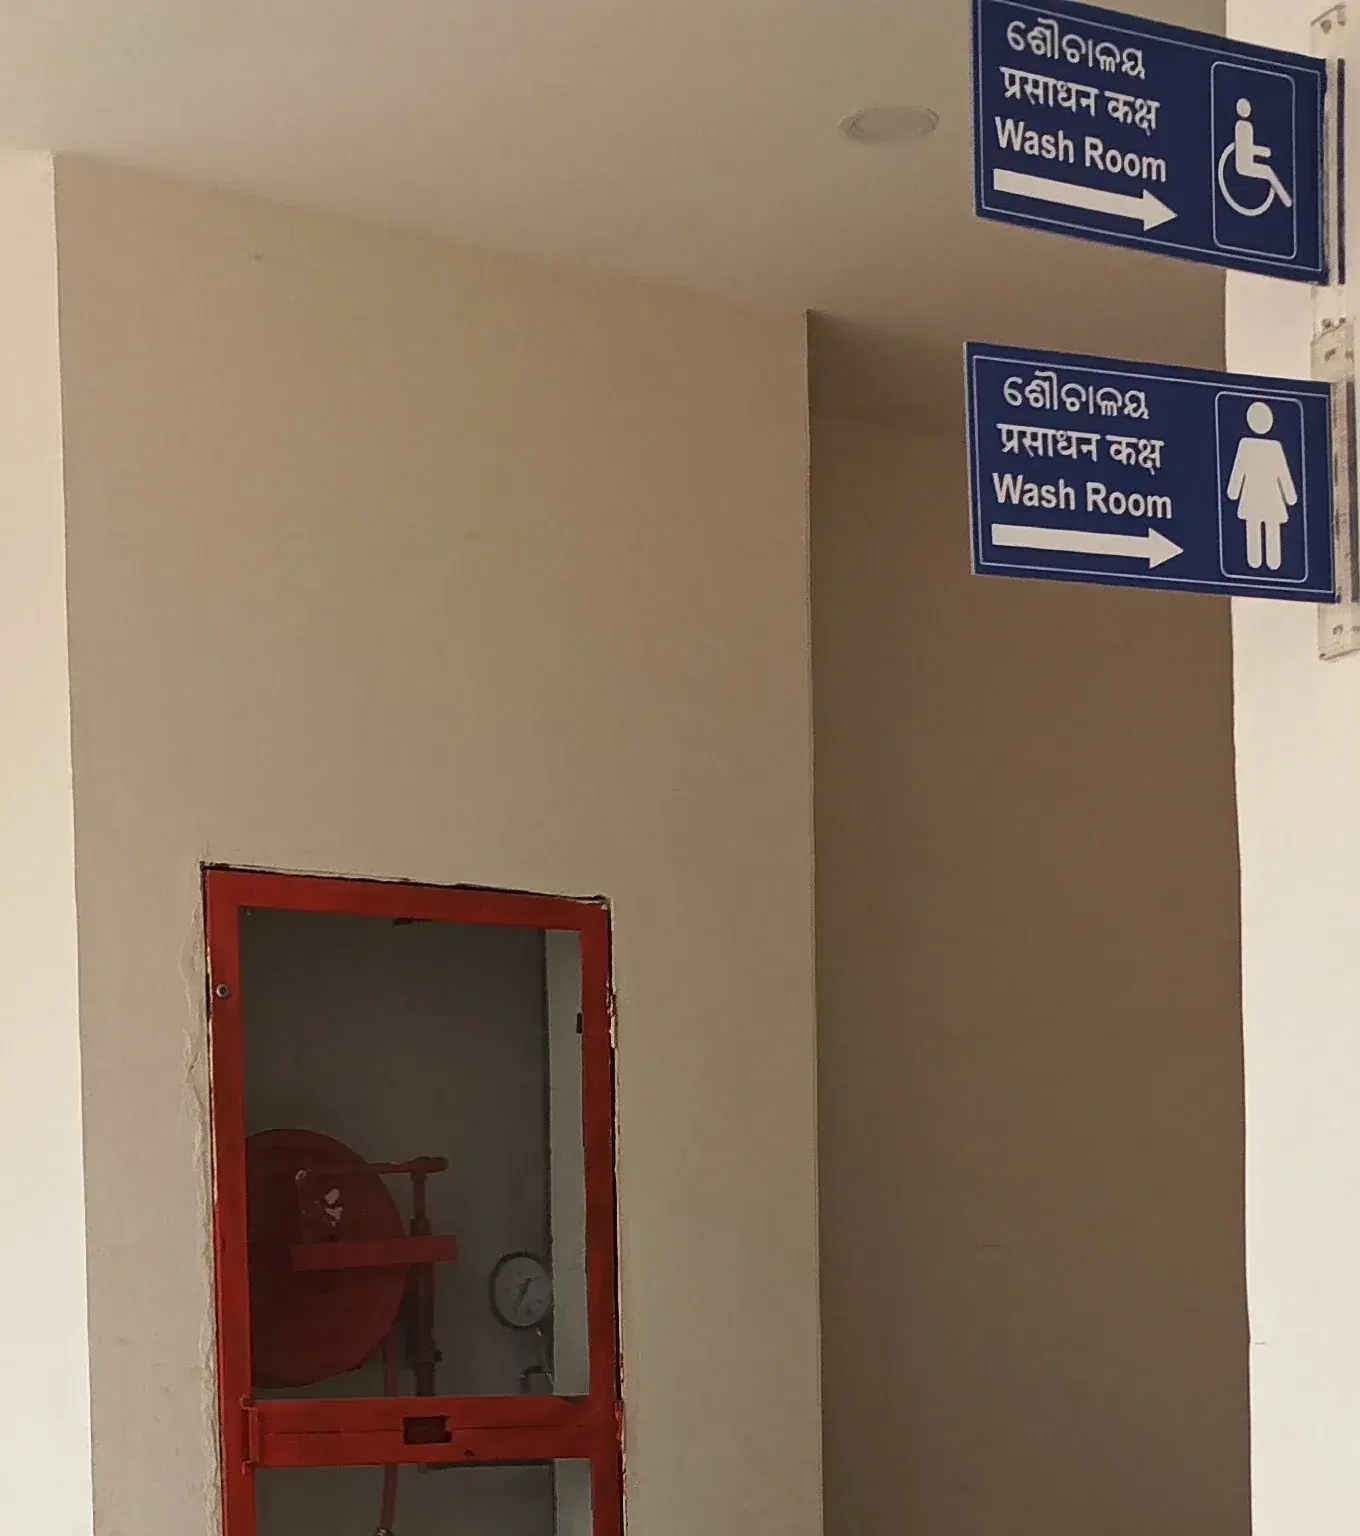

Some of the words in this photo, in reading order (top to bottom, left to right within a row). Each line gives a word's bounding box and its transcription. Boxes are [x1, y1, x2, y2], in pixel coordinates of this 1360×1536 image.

[999, 66, 1100, 117] प्रसाधन
[1104, 90, 1160, 136] कक्ष
[994, 116, 1075, 164] Wash
[1084, 136, 1167, 183] Room
[996, 423, 1101, 462] प्रसाधन
[1105, 434, 1165, 476] कक्ष
[992, 472, 1076, 511] Wash
[1085, 481, 1172, 519] Room
